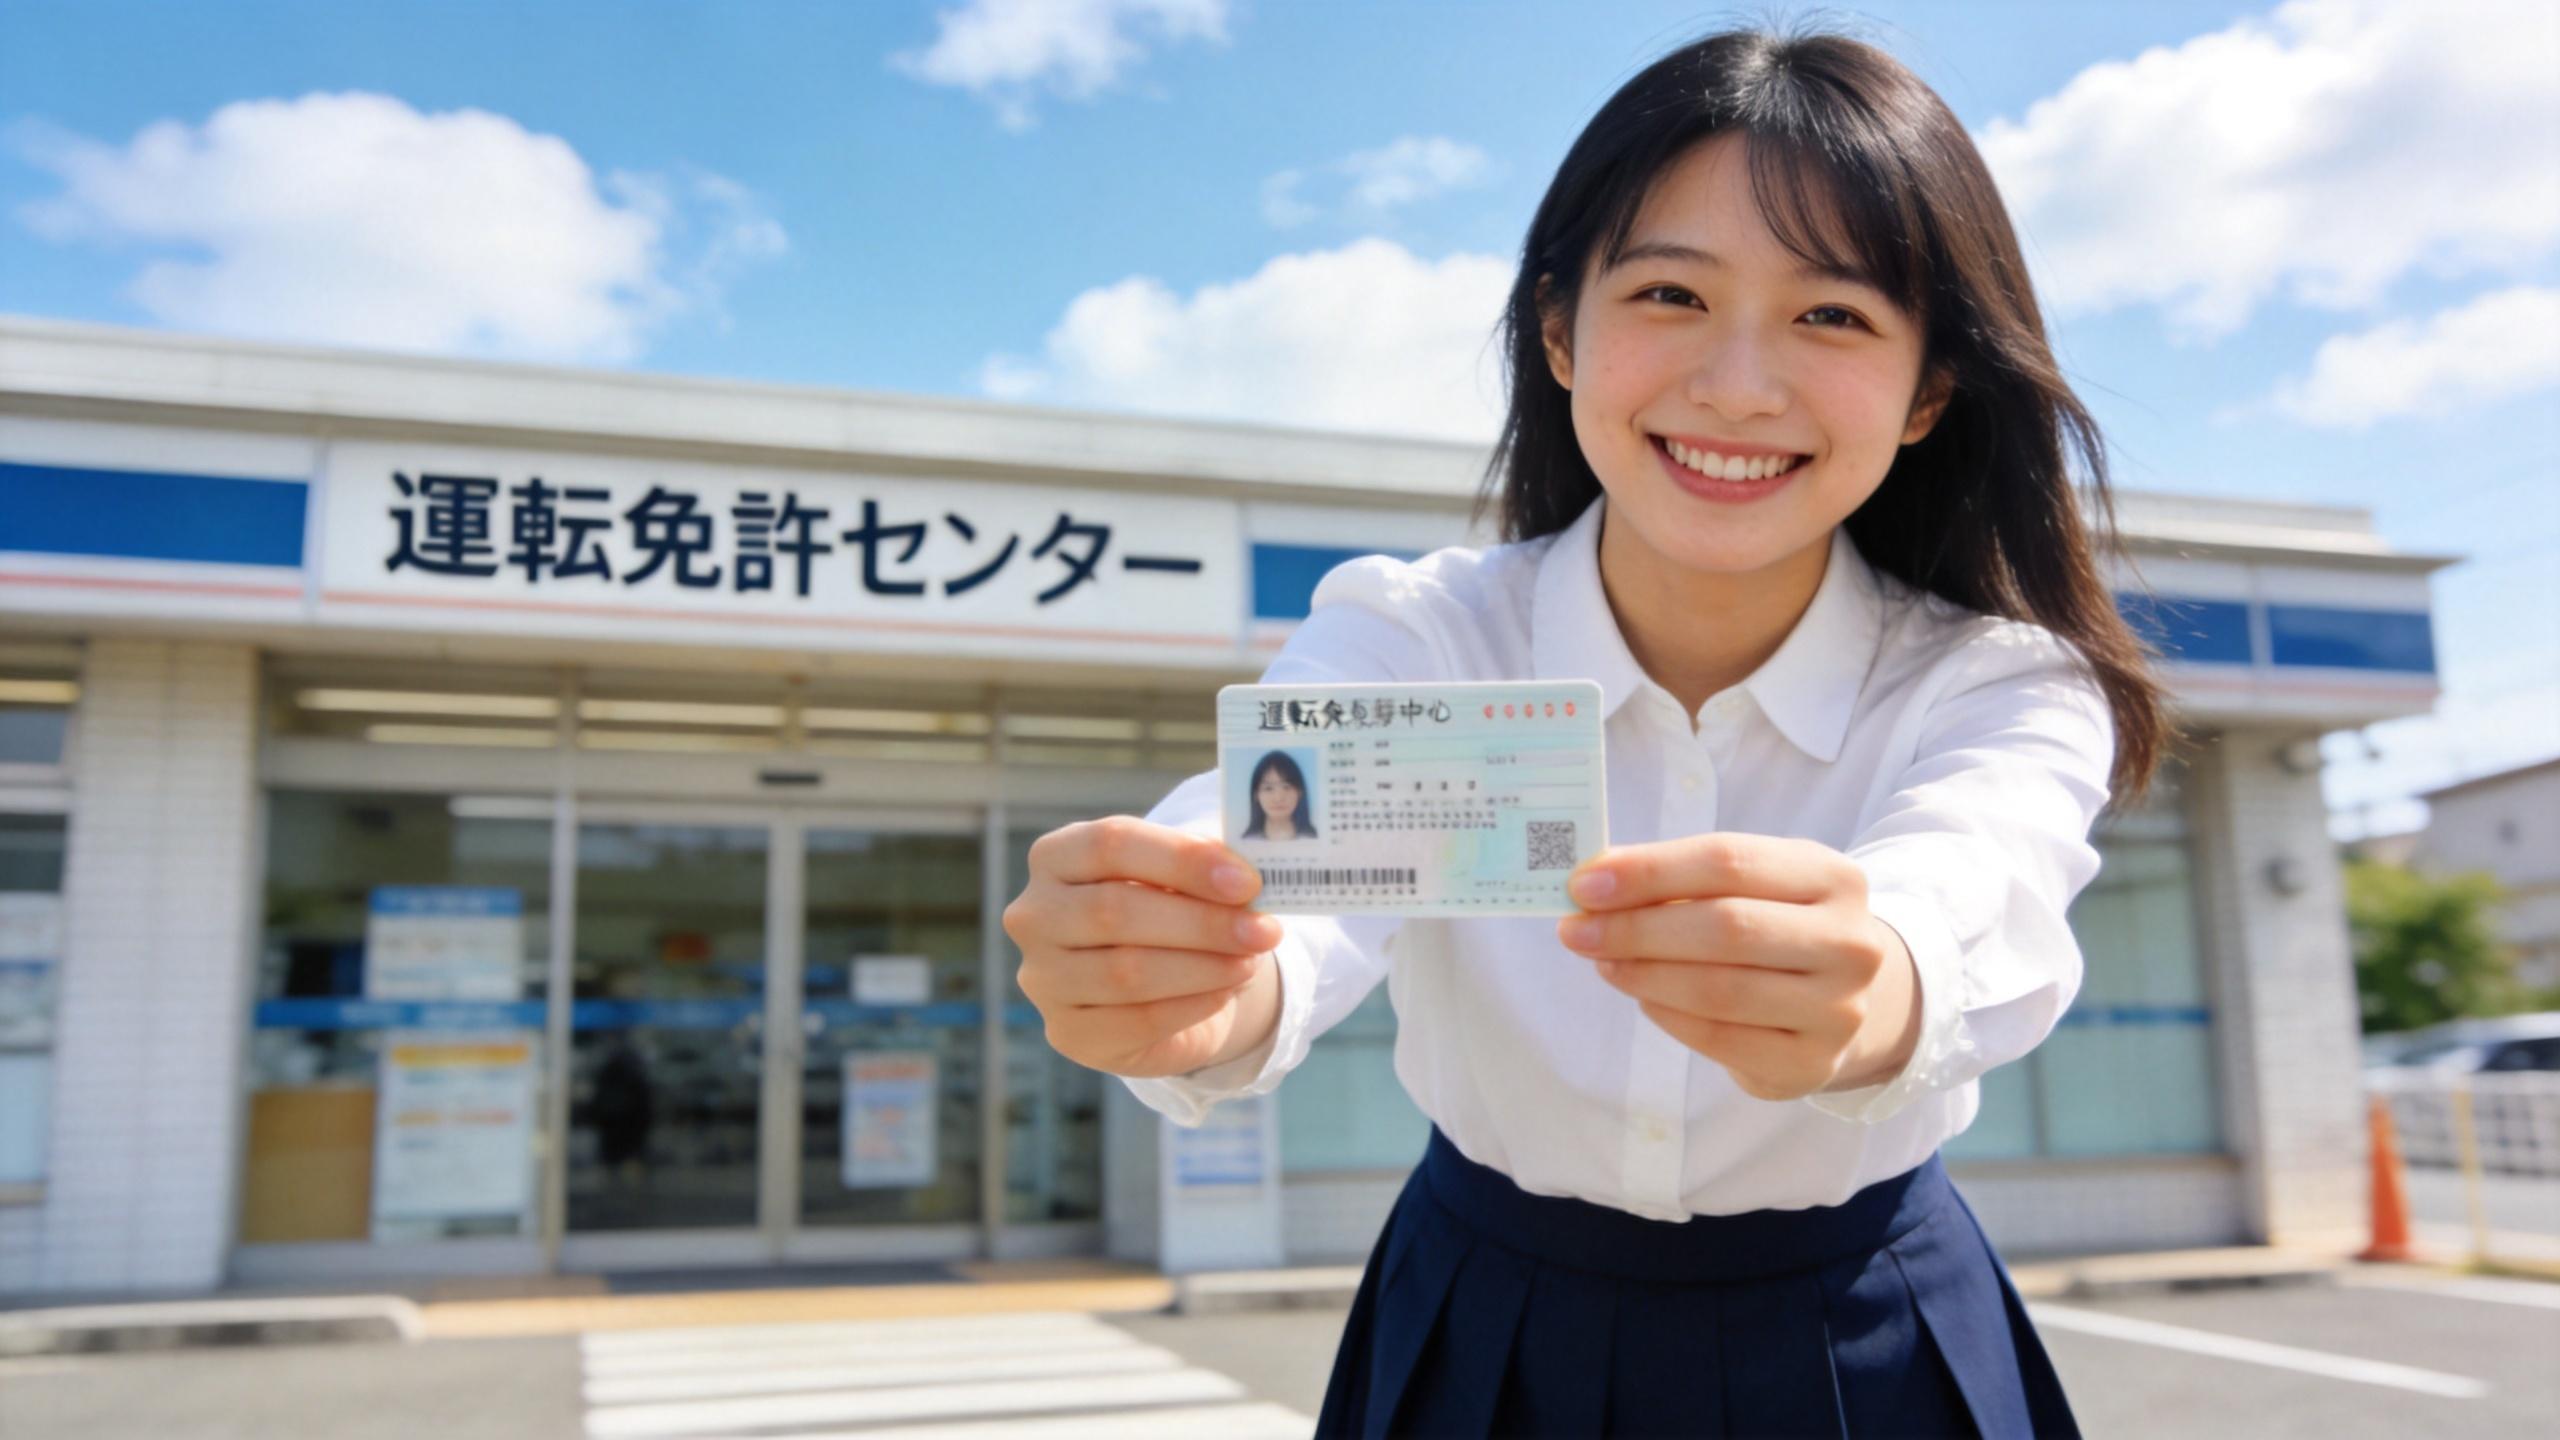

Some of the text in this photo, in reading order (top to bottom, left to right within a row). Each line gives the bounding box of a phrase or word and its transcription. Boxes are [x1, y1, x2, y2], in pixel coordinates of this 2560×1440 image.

[385, 471, 1204, 605] 運転免許センター
